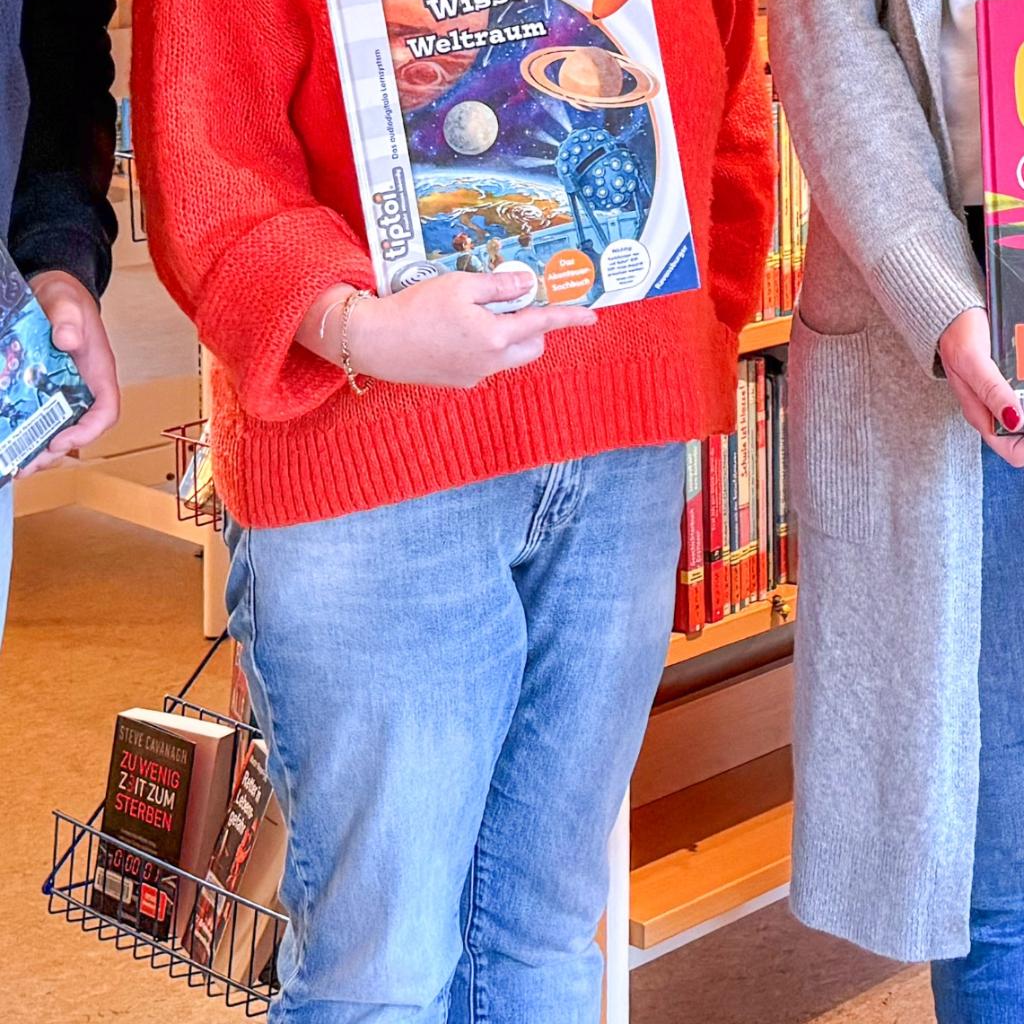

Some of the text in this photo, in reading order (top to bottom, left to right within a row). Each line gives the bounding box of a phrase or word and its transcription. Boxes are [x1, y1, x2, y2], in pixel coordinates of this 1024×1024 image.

[407, 21, 548, 59] Weltraum
[372, 191, 411, 261] tiptoi
[559, 258, 576, 267] Das
[653, 244, 689, 291] Ravensburger
[120, 725, 188, 764] STEVE CAVANAGH
[120, 750, 180, 789] ZU WENIG
[114, 792, 173, 832] STERBEN
[146, 782, 176, 811] ZUM
